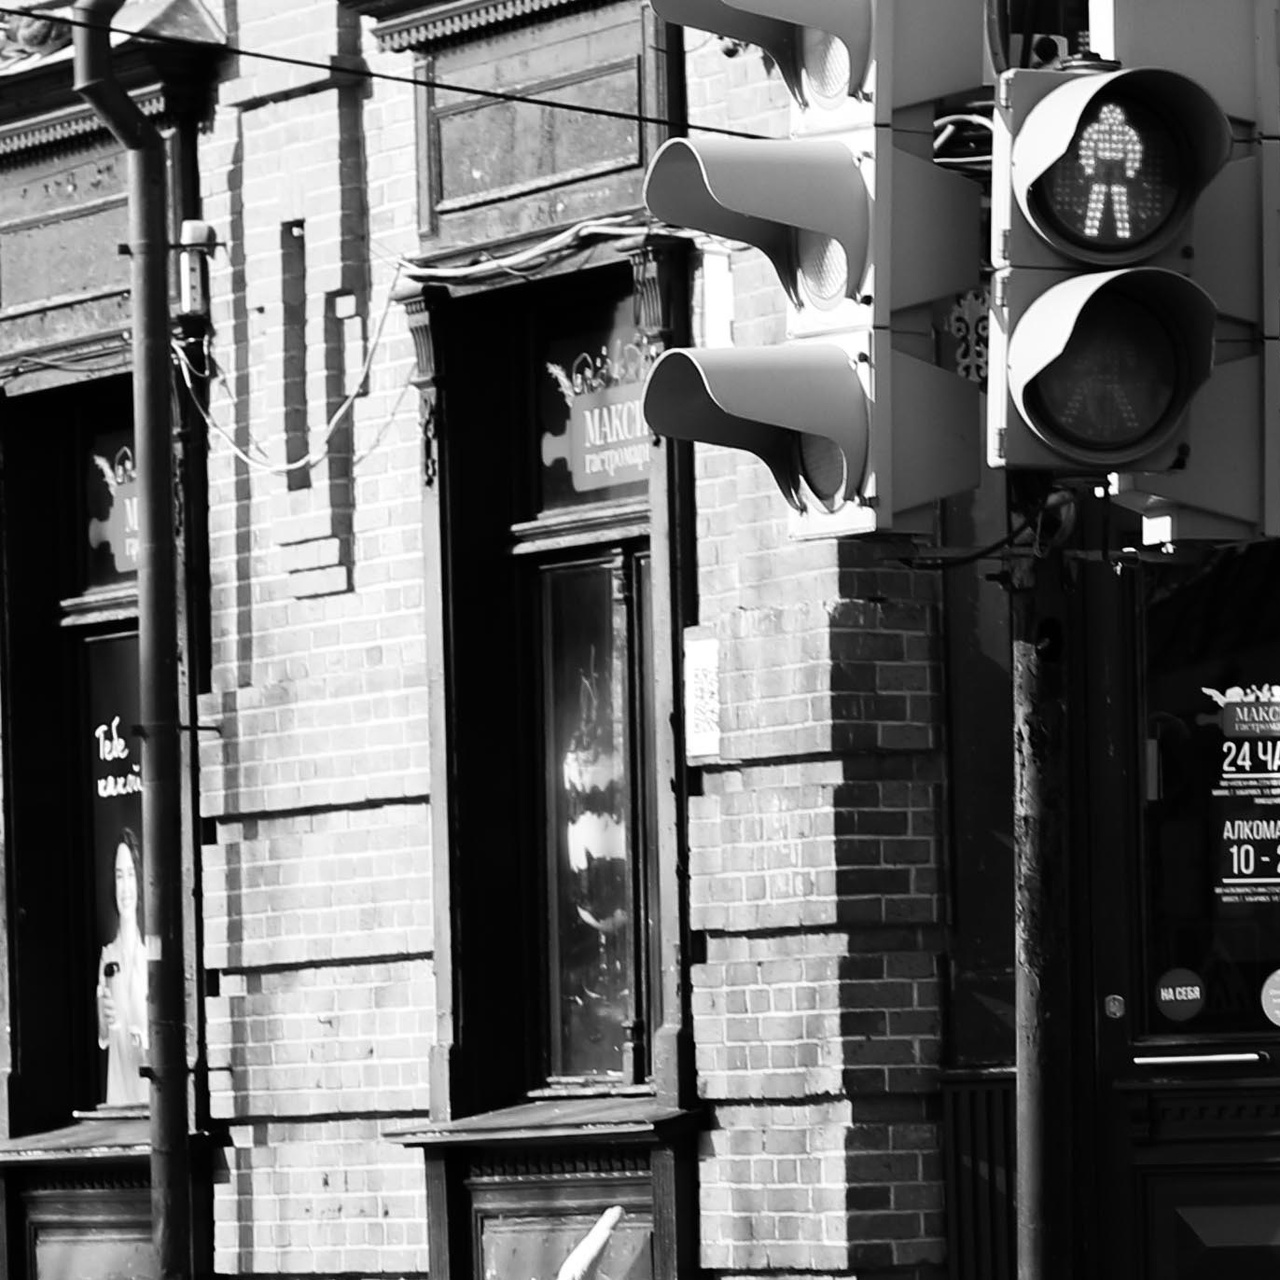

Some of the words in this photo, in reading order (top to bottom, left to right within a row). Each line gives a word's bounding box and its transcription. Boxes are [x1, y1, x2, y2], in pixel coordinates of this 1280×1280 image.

[1222, 741, 1252, 771] 24
[1229, 843, 1255, 874] 10
[1160, 987, 1174, 1001] НА
[1175, 985, 1200, 1000] СЕБЯ
